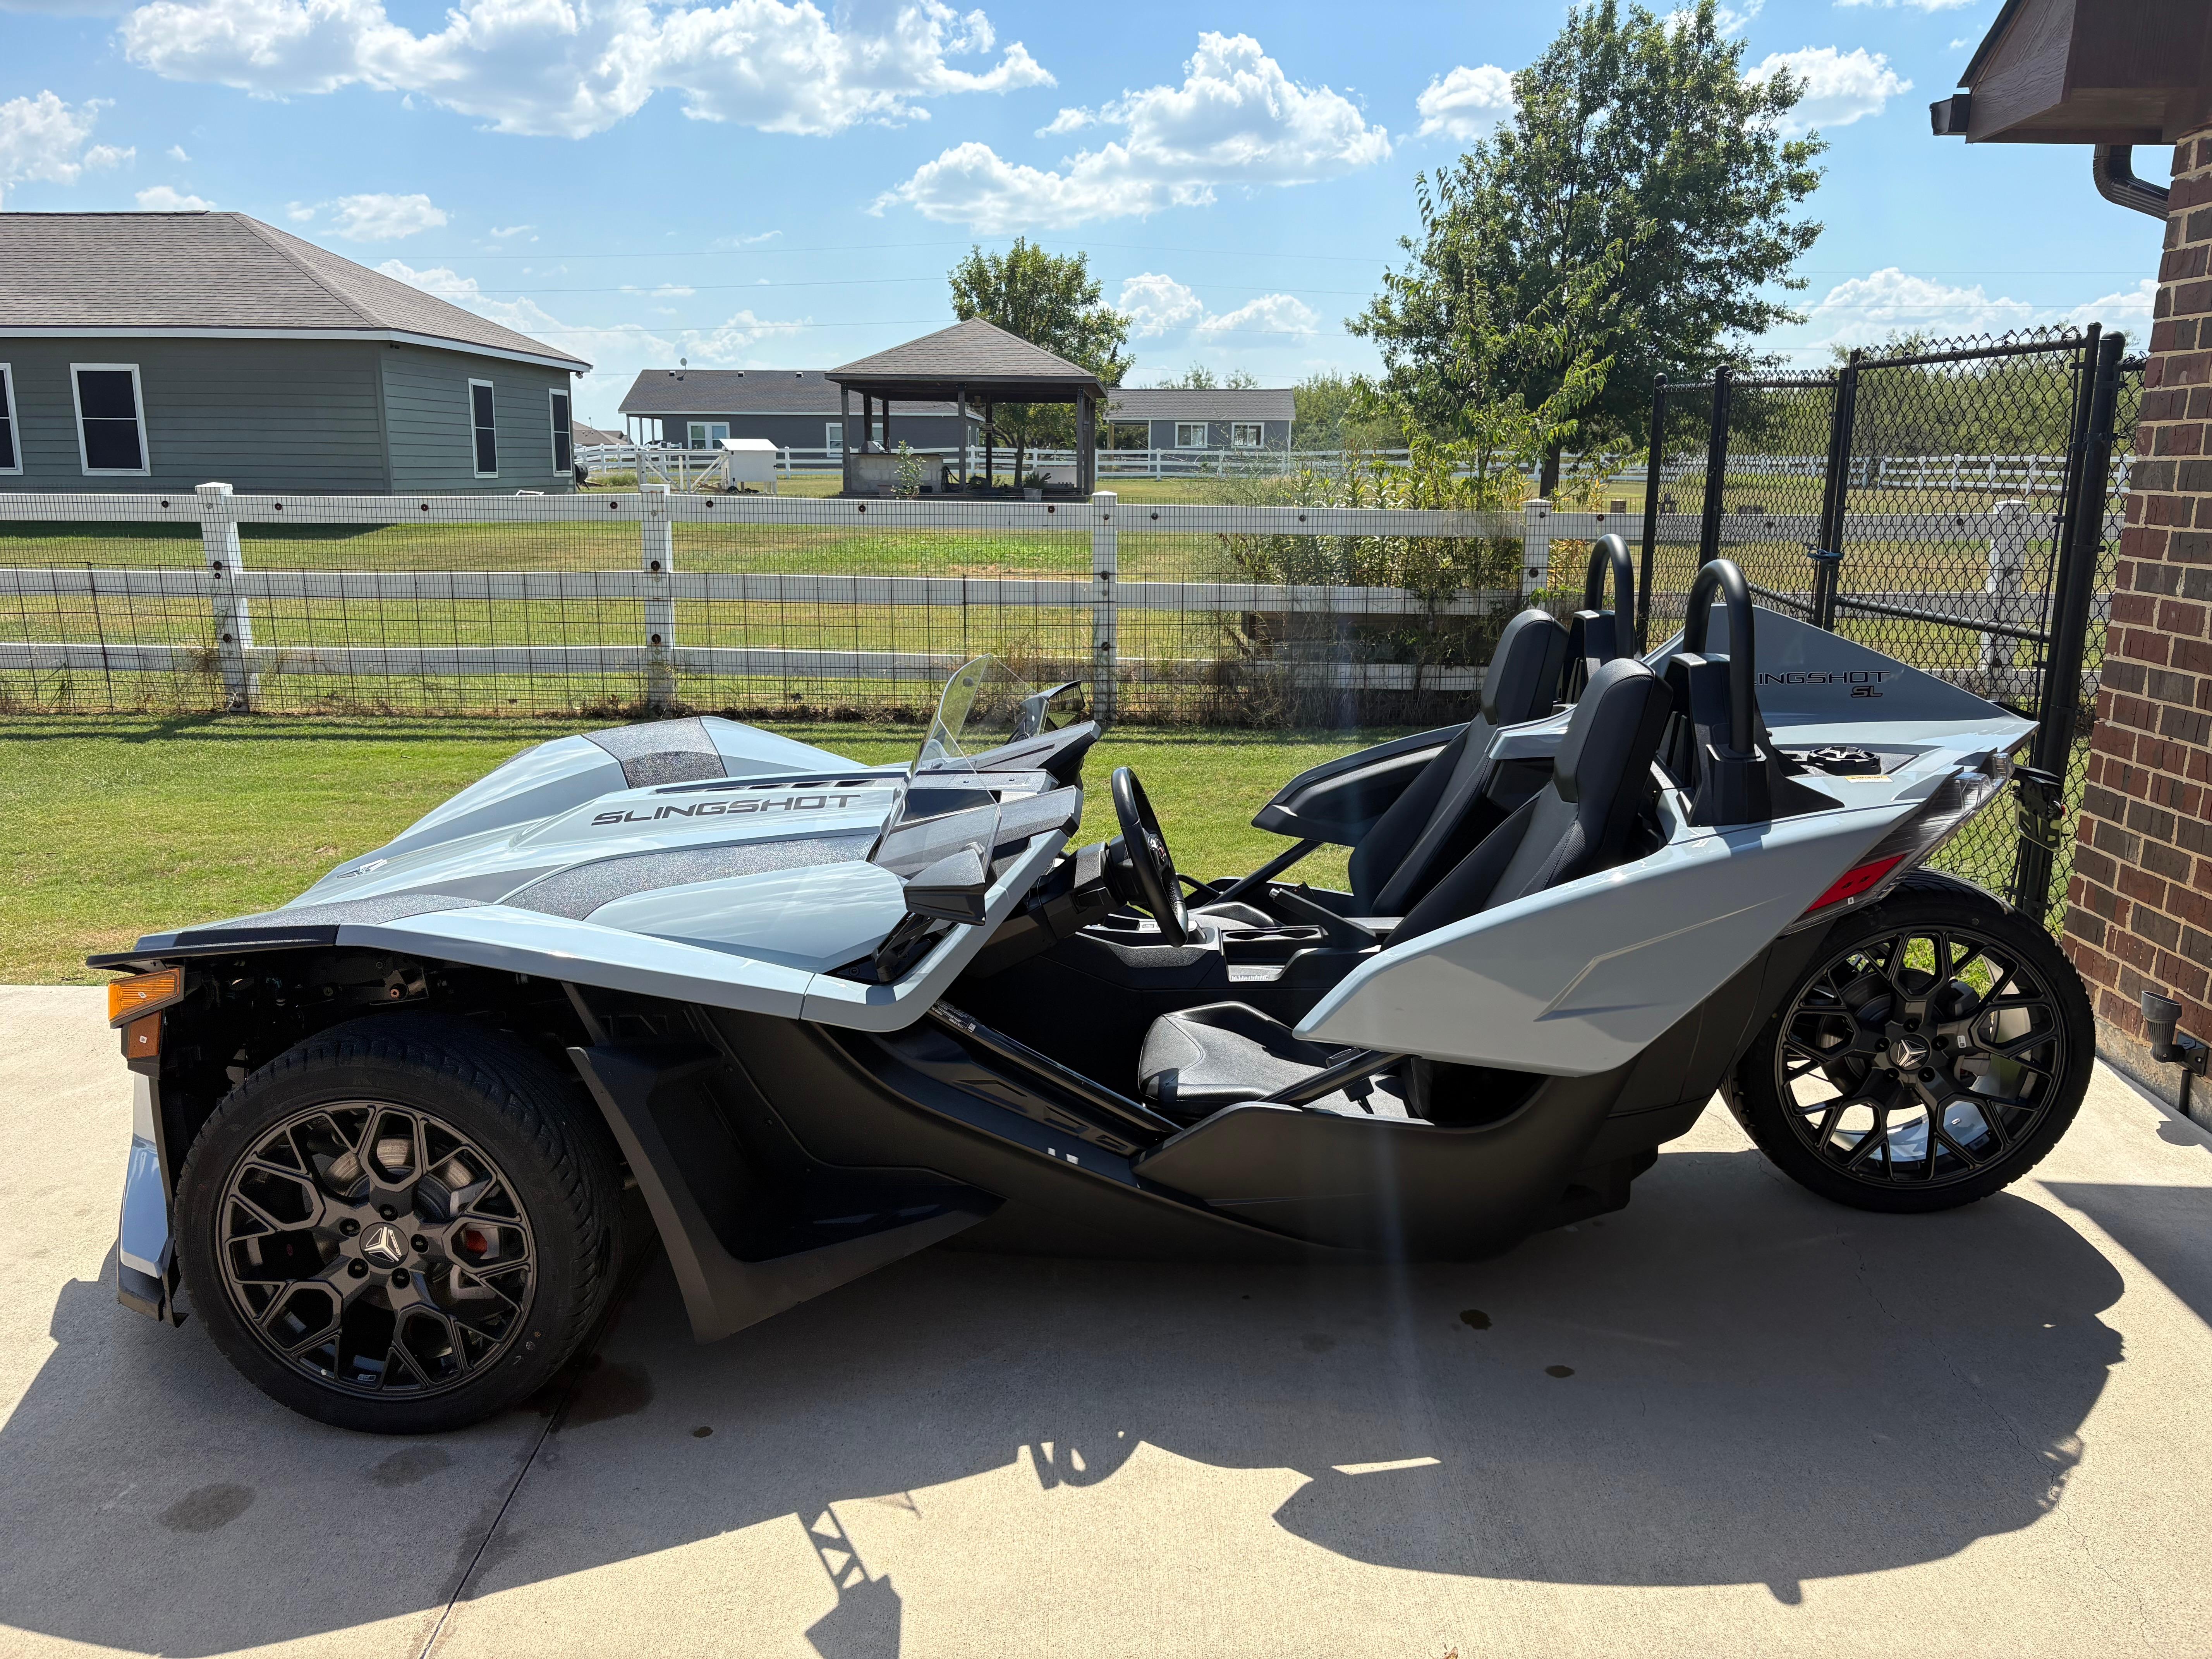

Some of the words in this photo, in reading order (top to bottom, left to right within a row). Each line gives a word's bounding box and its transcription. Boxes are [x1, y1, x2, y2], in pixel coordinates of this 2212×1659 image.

[1755, 671, 1890, 685] INGSHOT
[1851, 685, 1883, 698] SL
[591, 794, 862, 826] SLINGSHOT
